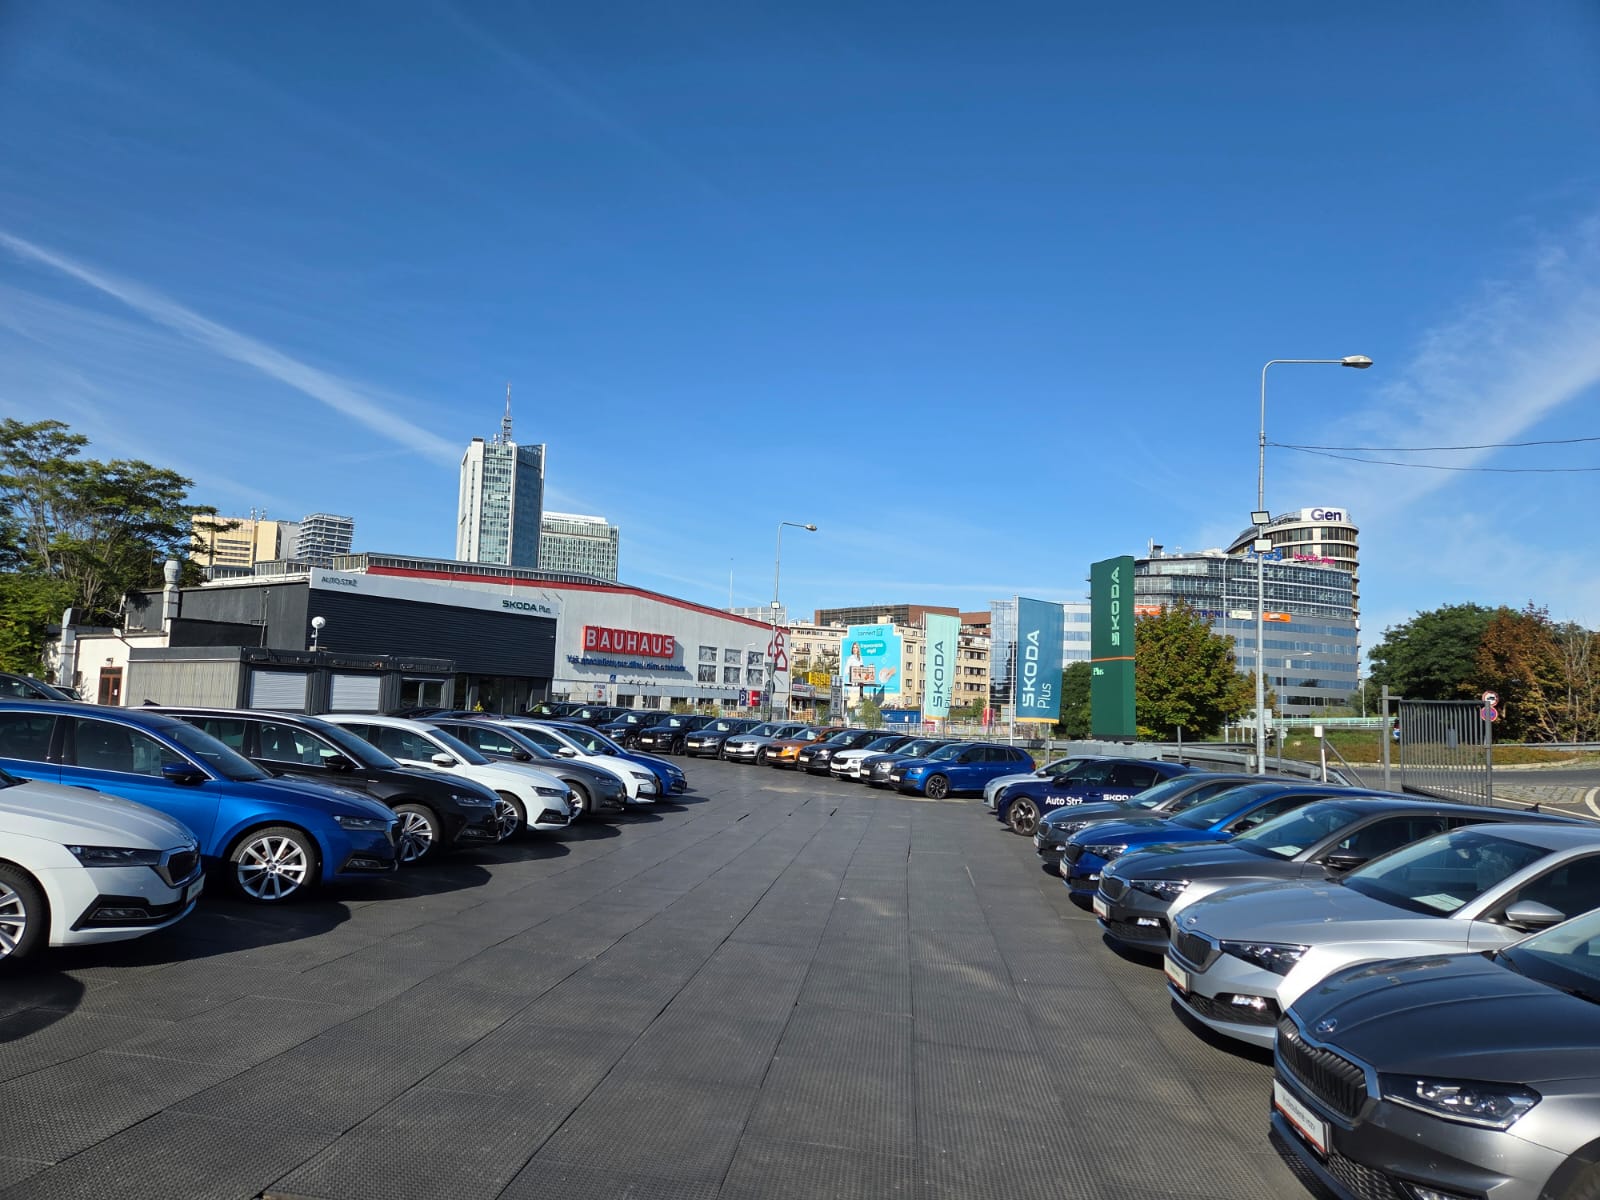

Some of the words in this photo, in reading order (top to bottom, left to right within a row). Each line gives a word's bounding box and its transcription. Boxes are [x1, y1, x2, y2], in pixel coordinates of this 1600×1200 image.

[1311, 508, 1342, 521] Gen
[587, 630, 673, 655] BAUHAUS
[1037, 682, 1052, 710] Plus
[1045, 795, 1065, 805] Auto
[1102, 793, 1134, 801] SKOD
